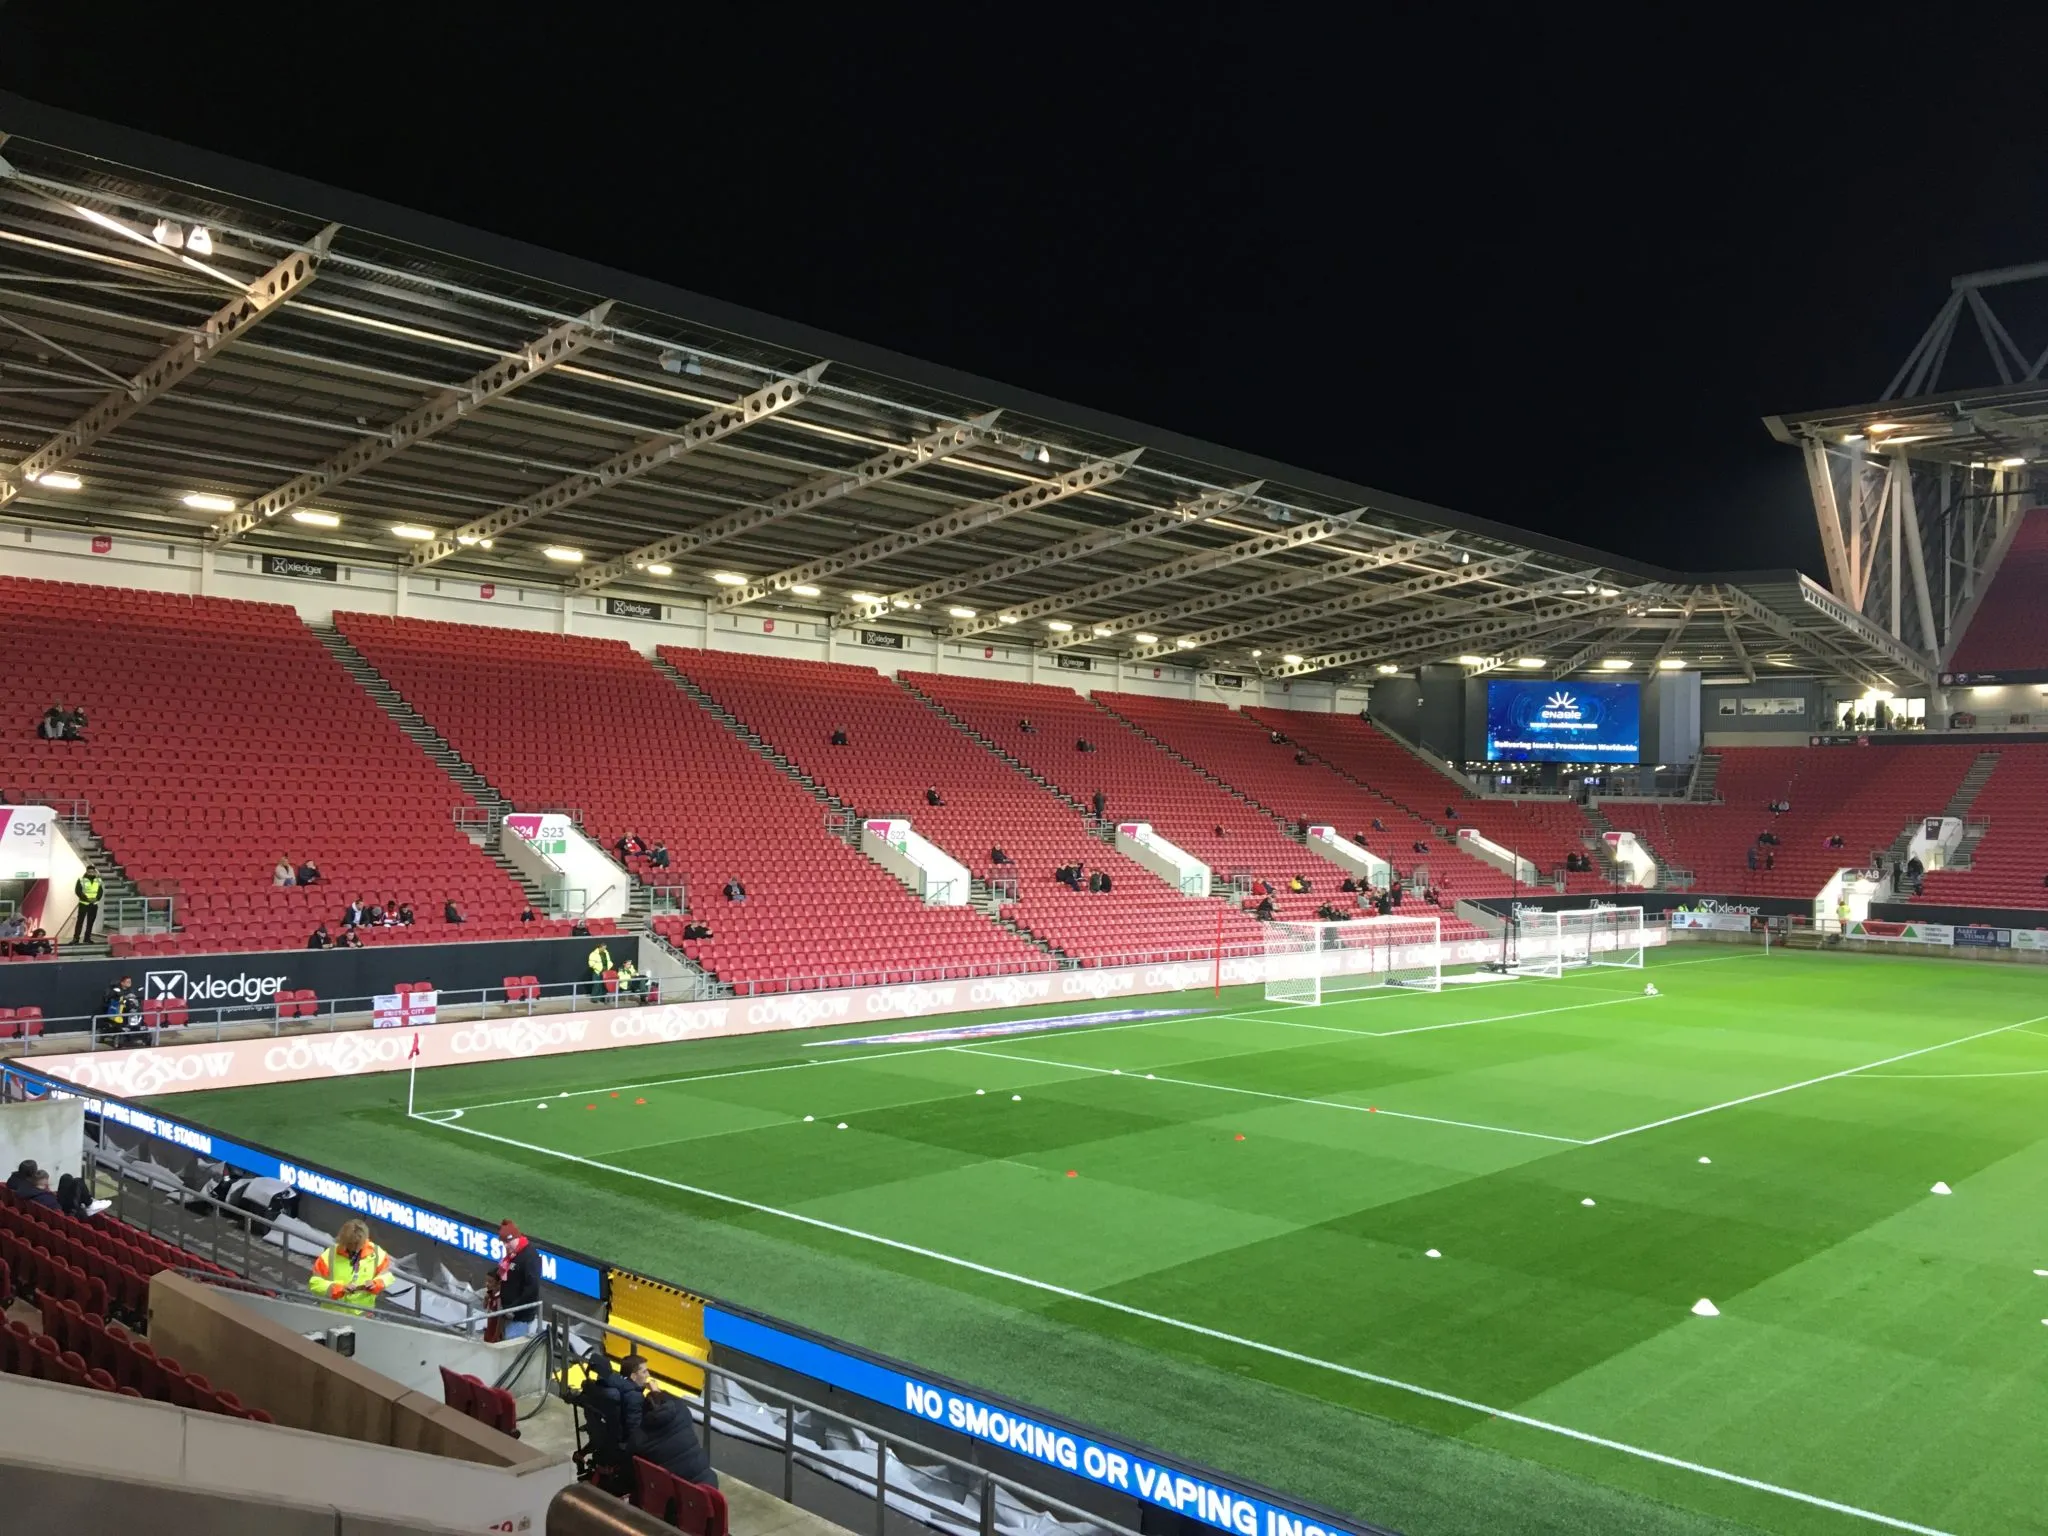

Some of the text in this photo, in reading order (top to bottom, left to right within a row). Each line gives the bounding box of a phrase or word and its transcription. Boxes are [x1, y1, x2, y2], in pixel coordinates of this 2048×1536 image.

[288, 562, 323, 575] xledger
[625, 604, 652, 616] xledger
[13, 822, 47, 836] S24
[542, 827, 565, 838] S23
[890, 831, 906, 840] S22
[188, 972, 288, 1003] xledger
[157, 1119, 175, 1141] THE
[174, 1126, 212, 1155] STADIUM
[279, 1162, 488, 1258] NO SMOKING OR VAPING INSIDE THE
[905, 1381, 943, 1420] NO
[948, 1398, 1078, 1469] SMOKING
[1083, 1446, 1129, 1488] OR
[1134, 1463, 1258, 1536] VAPING
